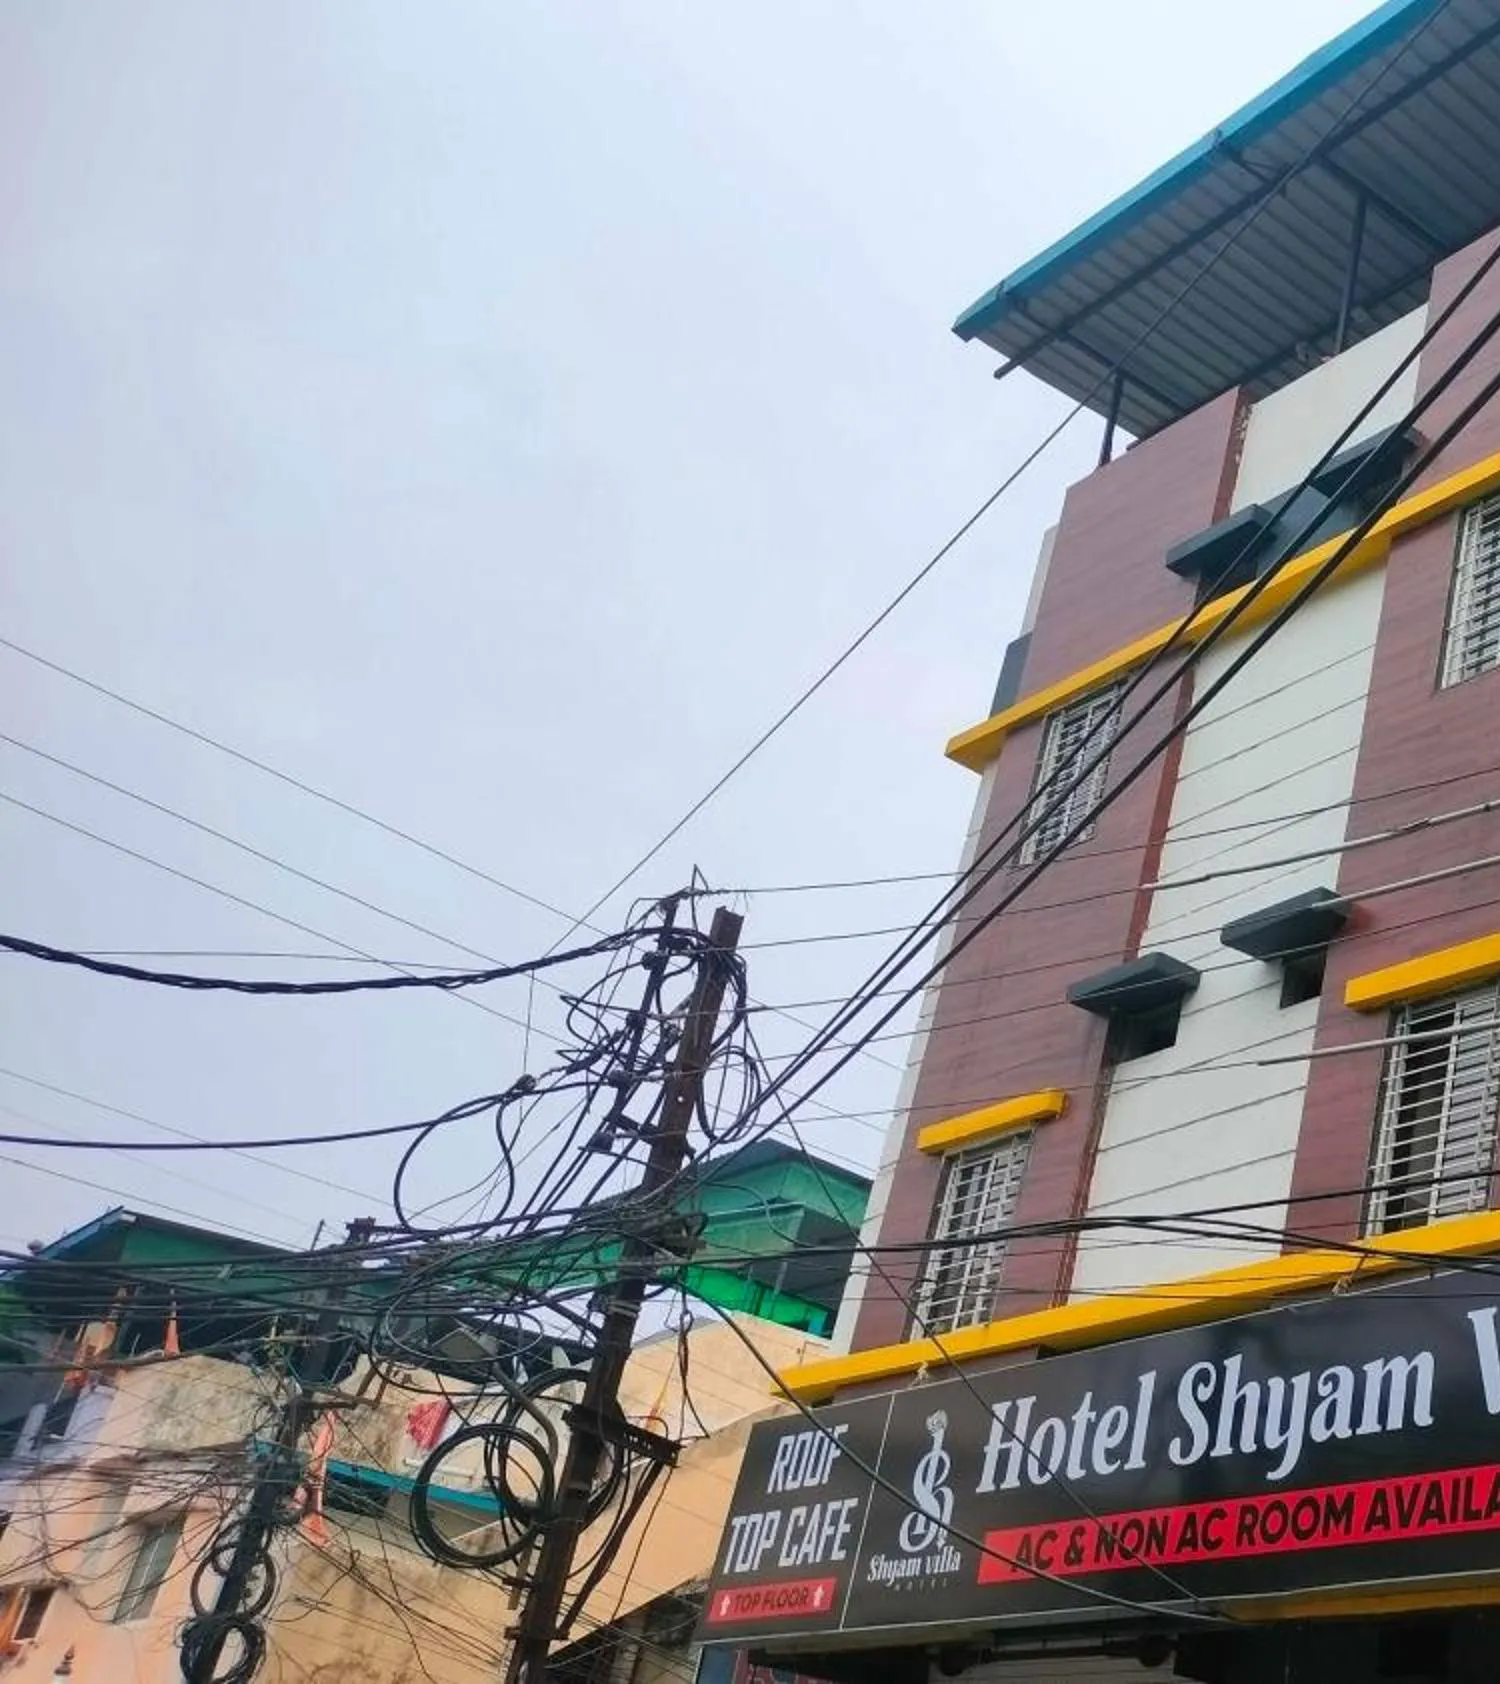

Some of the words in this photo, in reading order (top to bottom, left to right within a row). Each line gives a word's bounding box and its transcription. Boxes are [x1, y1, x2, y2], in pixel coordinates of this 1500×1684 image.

[976, 1370, 1157, 1494] Hotel
[1168, 1349, 1435, 1480] Shyam
[767, 1424, 849, 1494] ROOF
[723, 1510, 782, 1575] TOP
[777, 1498, 858, 1568] CAFE
[1010, 1531, 1058, 1572] AC
[1064, 1525, 1085, 1566] &
[1095, 1514, 1168, 1562] NON
[1175, 1508, 1227, 1553] AC
[1235, 1493, 1354, 1548] ROOM
[733, 1592, 761, 1614] TOP
[761, 1585, 809, 1611] FLOOR
[867, 1553, 922, 1588] Shyam
